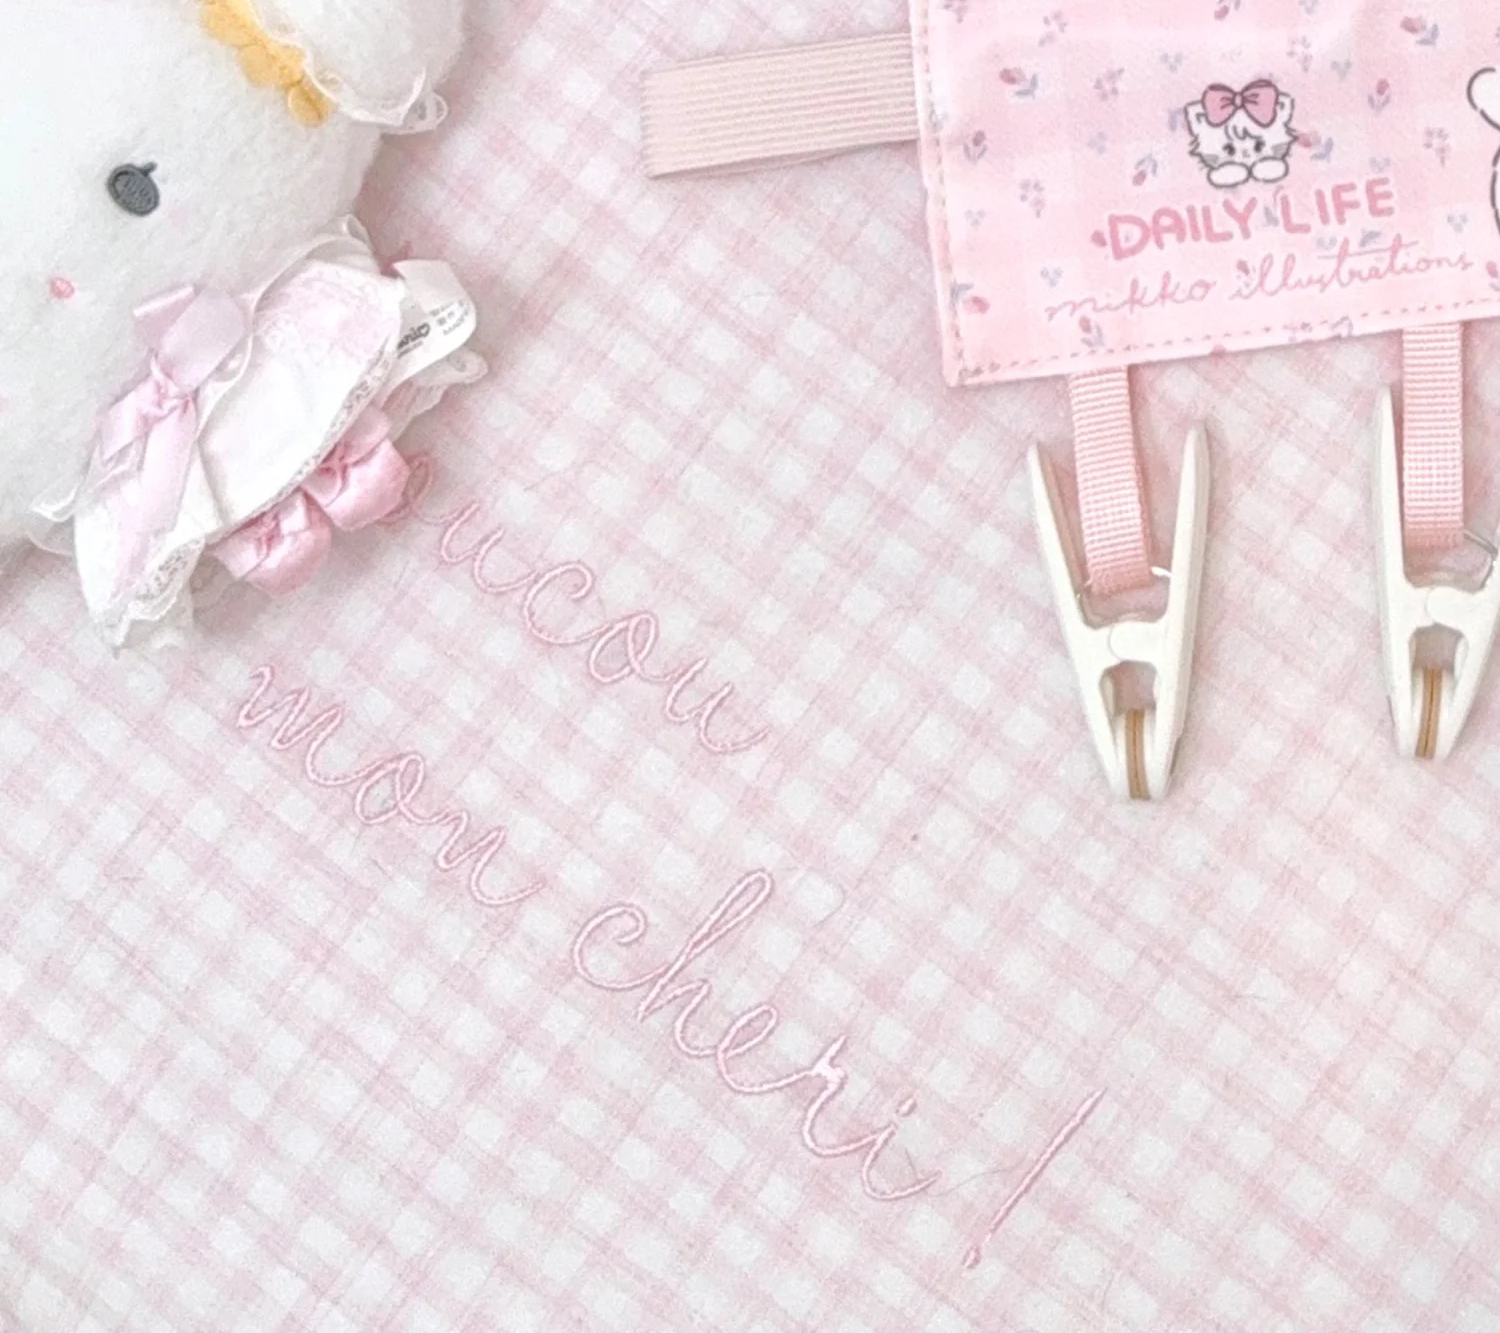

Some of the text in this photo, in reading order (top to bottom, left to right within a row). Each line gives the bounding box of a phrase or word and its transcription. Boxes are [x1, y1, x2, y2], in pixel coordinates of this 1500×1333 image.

[1107, 176, 1396, 260] DAILY LIFE
[1044, 234, 1476, 322] mikko illustrations
[236, 665, 543, 906] mon
